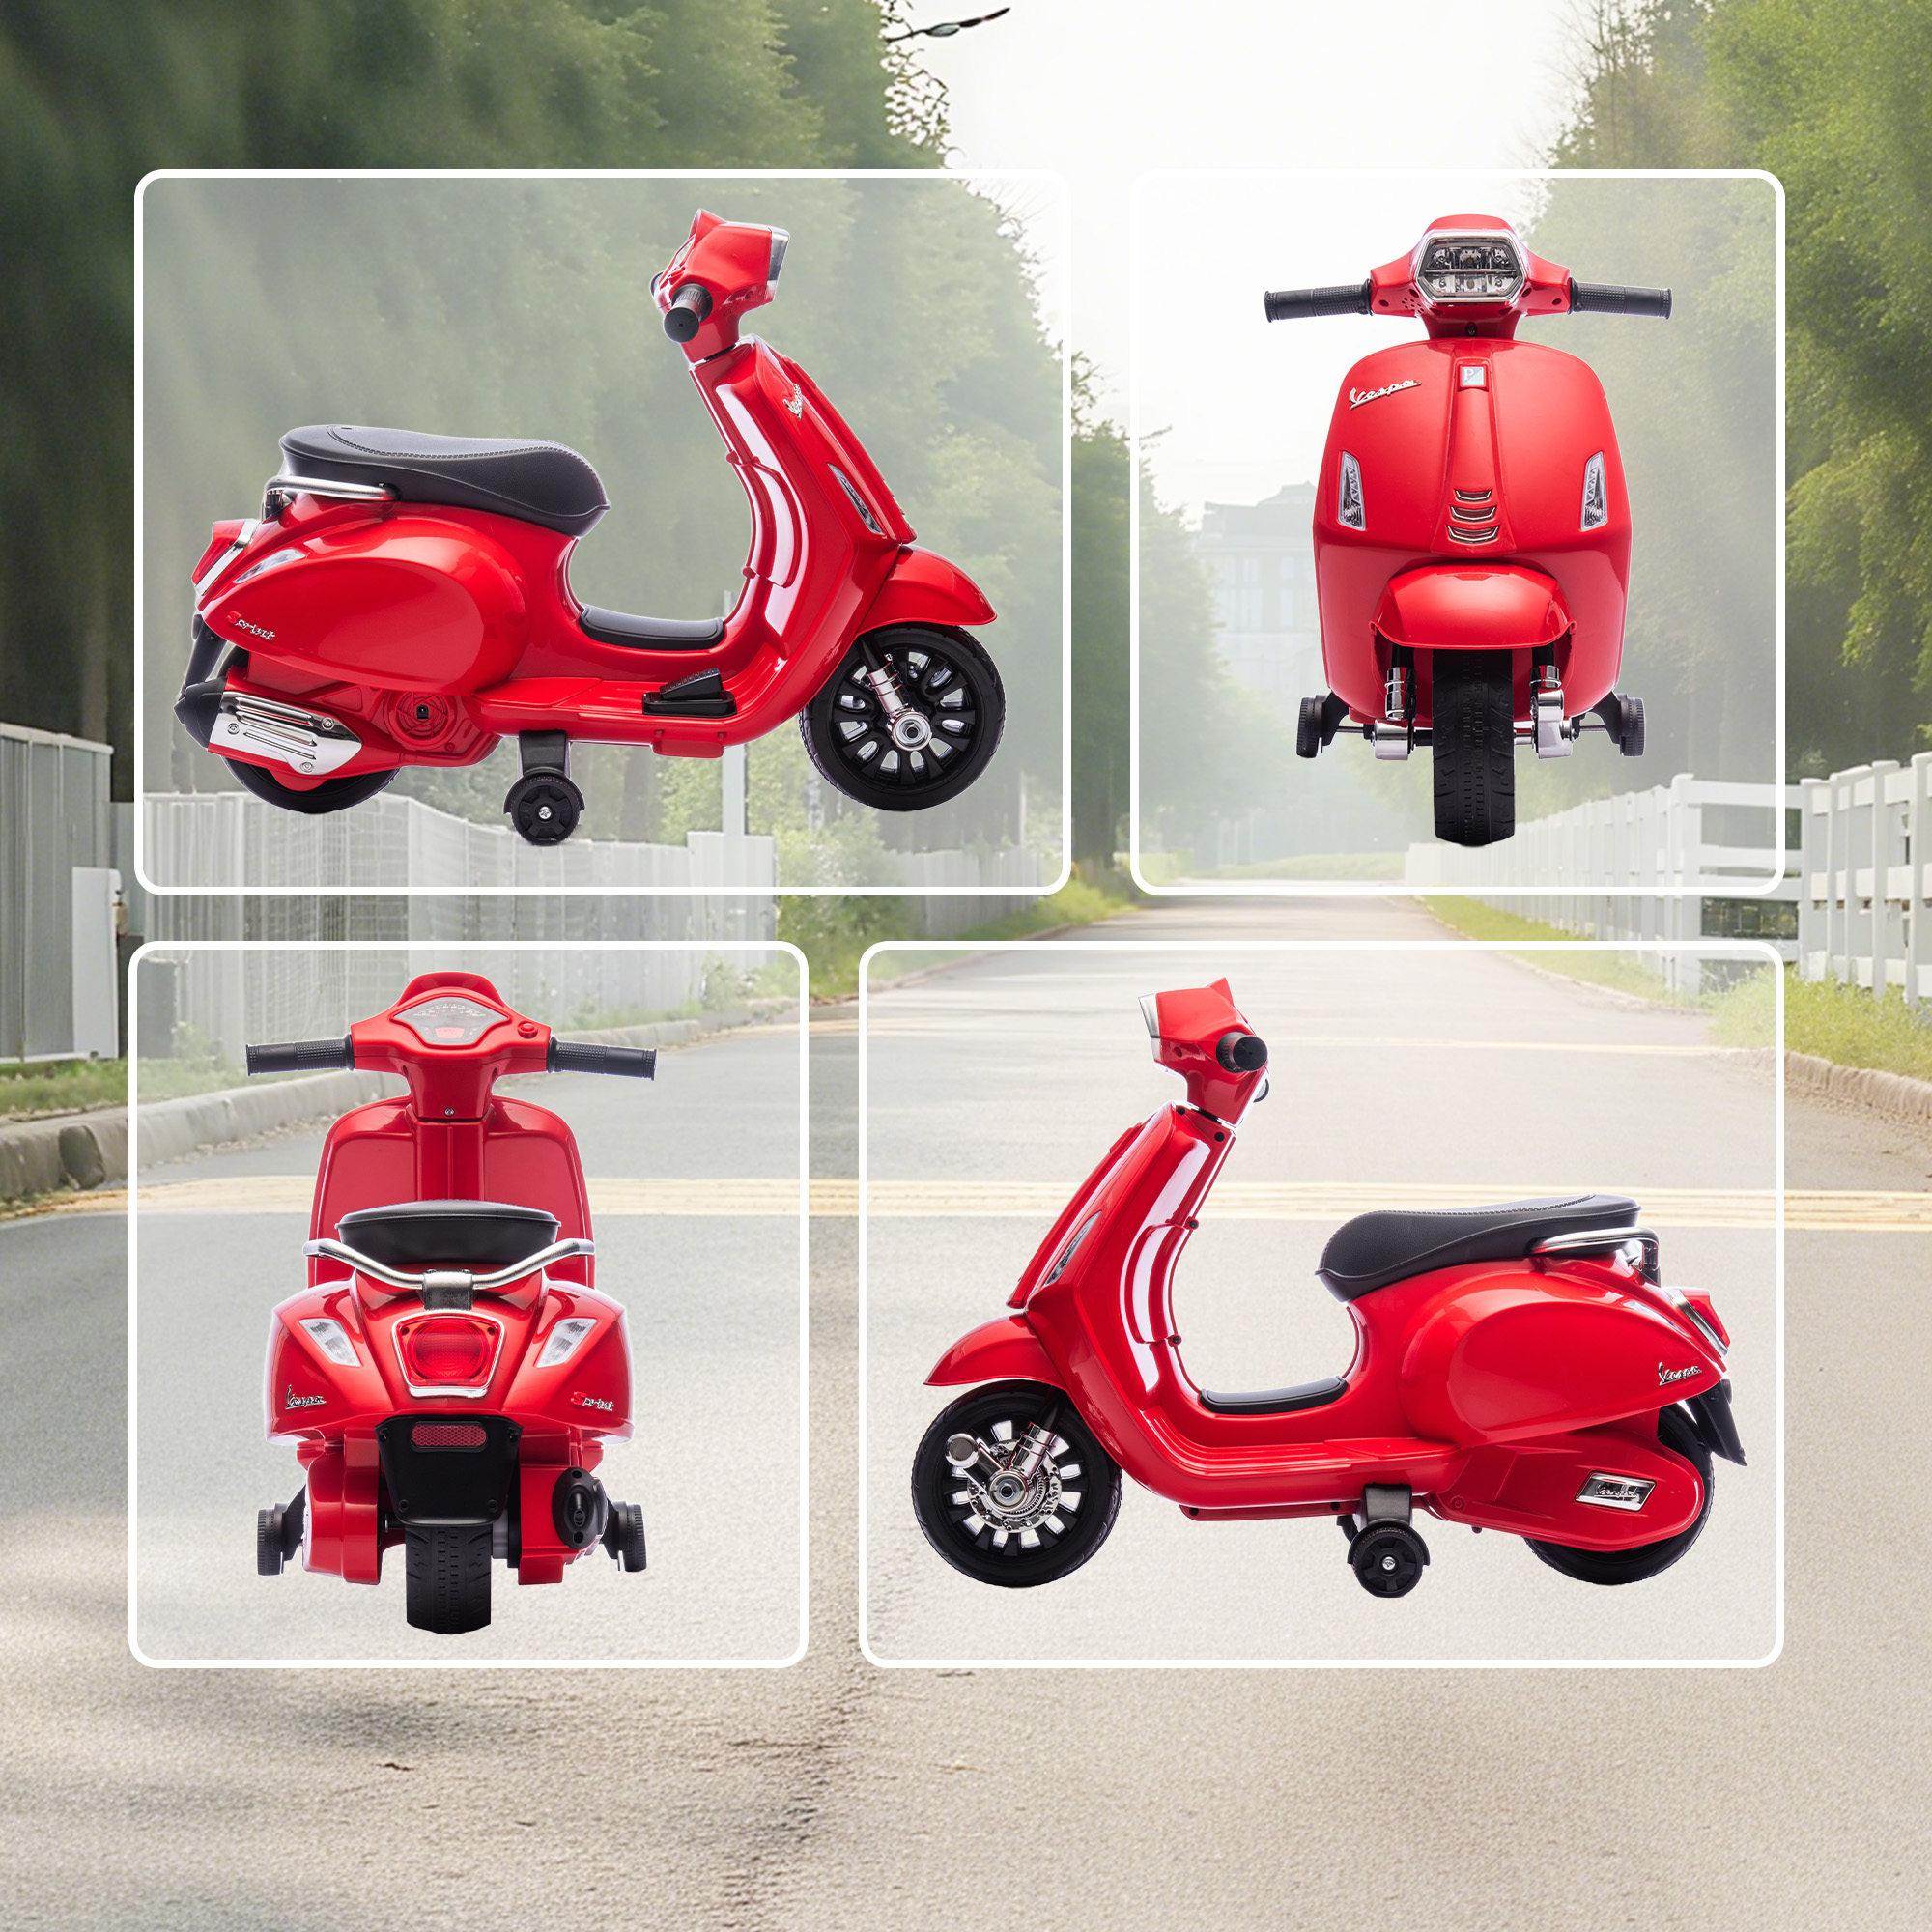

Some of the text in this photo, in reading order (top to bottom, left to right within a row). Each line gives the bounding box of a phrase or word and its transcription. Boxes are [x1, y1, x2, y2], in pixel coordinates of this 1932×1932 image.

[1350, 380, 1422, 410] Vespa
[225, 611, 275, 640] Sprint
[1658, 1361, 1703, 1386] Vespa
[285, 1384, 327, 1410] Vespa
[570, 1391, 615, 1411] Sprint
